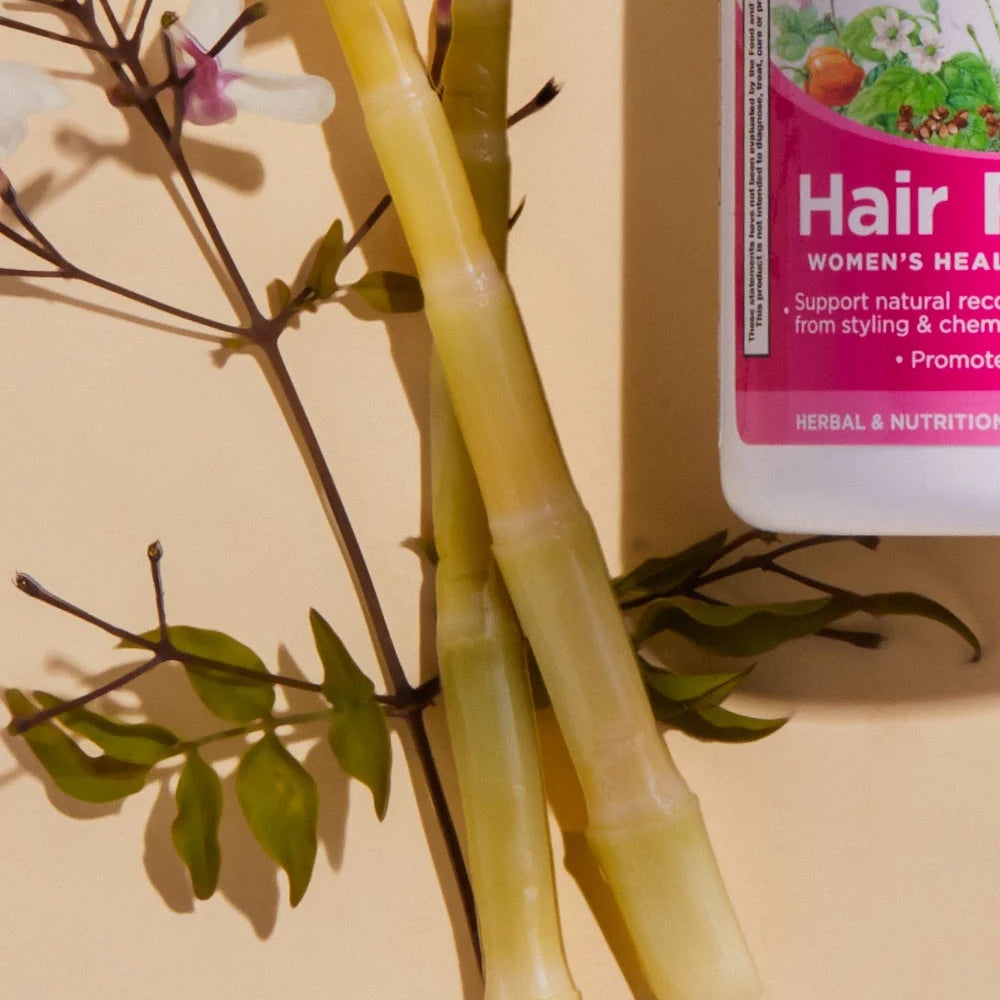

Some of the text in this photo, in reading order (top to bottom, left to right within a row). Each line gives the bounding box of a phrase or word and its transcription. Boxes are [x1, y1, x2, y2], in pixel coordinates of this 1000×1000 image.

[756, 93, 764, 149] diagnose,
[799, 169, 949, 237] Hair
[807, 252, 924, 272] WOMEN'S
[756, 256, 764, 300] product
[794, 291, 870, 315] Support
[875, 292, 949, 311] natural
[794, 314, 836, 335] from
[841, 314, 910, 338] styling
[916, 314, 932, 334] &
[796, 413, 867, 431] HERBAL
[870, 413, 884, 431] &
